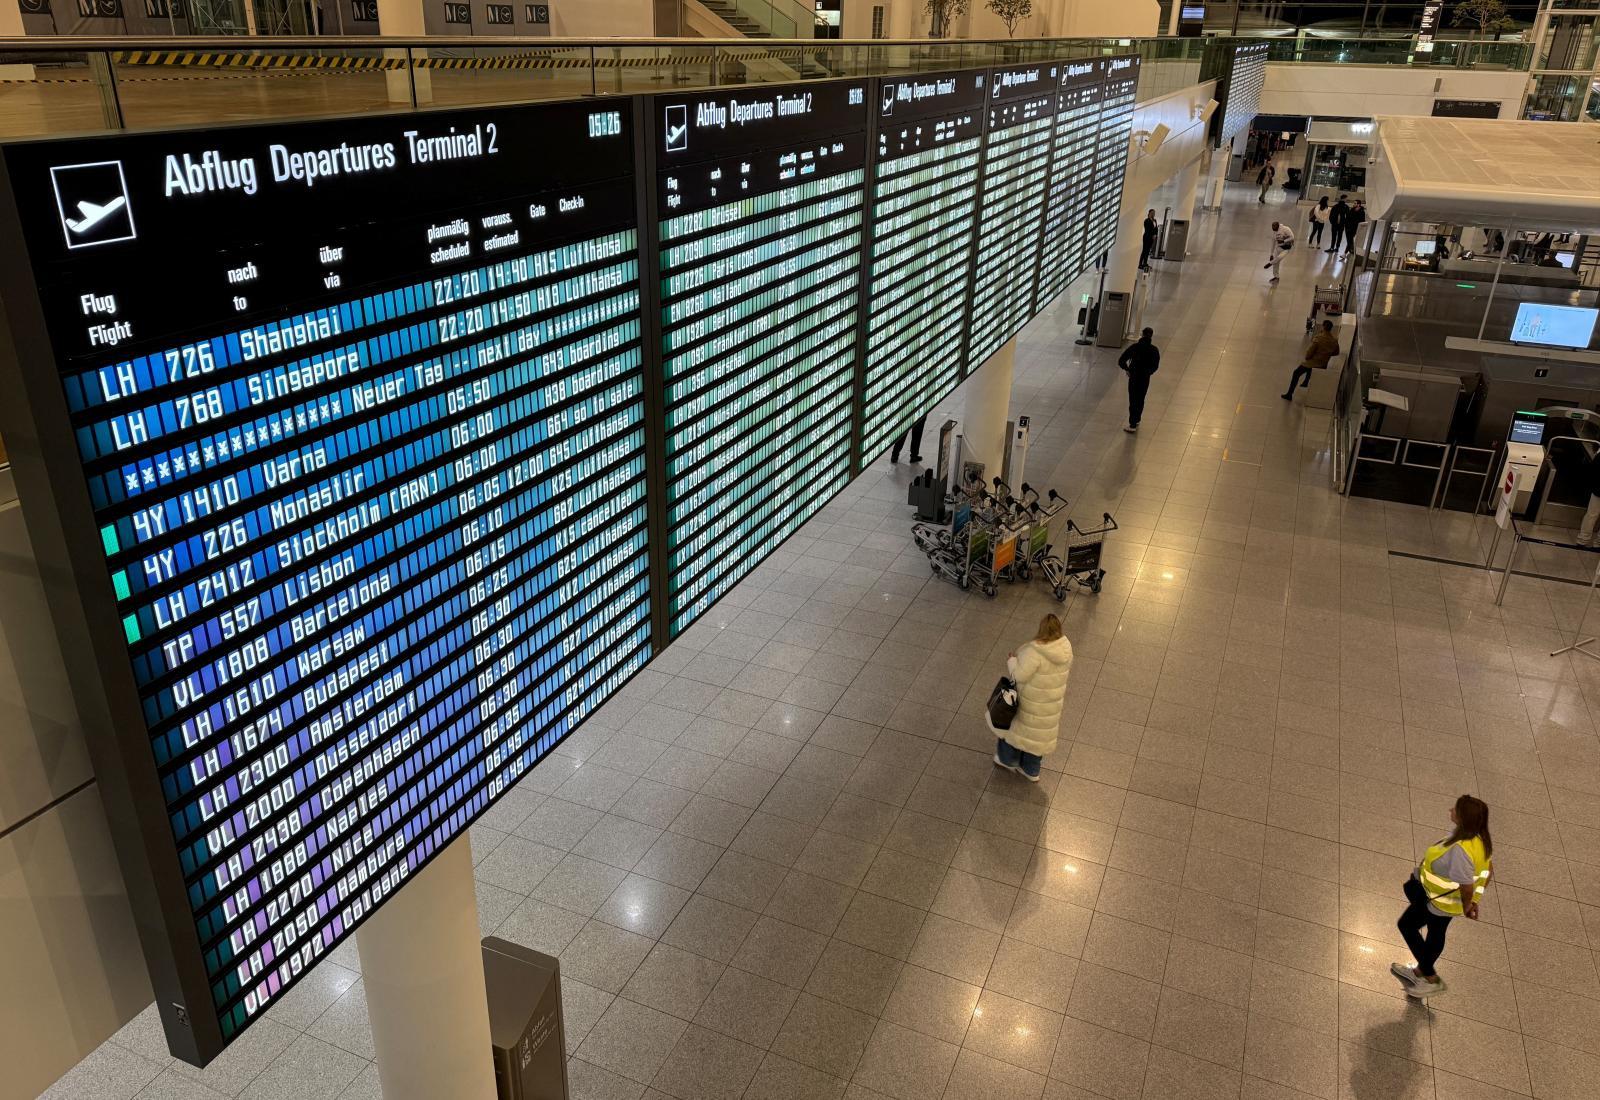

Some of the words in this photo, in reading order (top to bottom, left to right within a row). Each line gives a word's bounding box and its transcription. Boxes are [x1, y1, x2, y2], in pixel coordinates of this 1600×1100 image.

[166, 151, 257, 196] Abflug
[270, 142, 395, 186] Departures
[404, 125, 482, 163] Terminal
[487, 123, 498, 153] 2
[589, 112, 620, 137] 05:26
[668, 177, 677, 190] Flug
[696, 102, 726, 128] Abflug
[731, 100, 773, 126] Departures
[777, 93, 805, 116] Terminal
[807, 93, 812, 112] 2
[228, 262, 257, 283] nach
[320, 246, 343, 263] über
[428, 219, 469, 243] planmäßig
[482, 212, 512, 229] vorauss.
[430, 241, 470, 264] scheduled
[484, 230, 519, 251] estimated
[530, 204, 546, 218] Gate
[559, 195, 584, 212] Check-In
[668, 194, 680, 208] Flight
[712, 257, 733, 280] Paris
[81, 294, 116, 314] Flug
[88, 322, 132, 345] Flight
[99, 363, 137, 402] LH
[165, 343, 214, 382] 726
[240, 309, 341, 361] Shanghai
[434, 272, 479, 305] 22:20
[488, 259, 527, 290] 14:40
[562, 238, 620, 269] Lufthansa
[111, 412, 147, 450] LH
[175, 389, 222, 429] 768
[248, 351, 359, 405] Singapore
[438, 308, 483, 343] 22:20
[492, 293, 530, 326] 14:50
[565, 269, 622, 302] Lufthansa
[233, 296, 247, 310] to
[324, 272, 340, 288] via
[352, 377, 404, 412] Neuer
[414, 363, 443, 389] Tag
[478, 336, 510, 367] next
[518, 330, 539, 352] day
[712, 306, 737, 331] Berlin
[133, 505, 163, 539] 4Y
[183, 477, 239, 522] 1410
[263, 447, 326, 488] Varna
[447, 378, 490, 414] 05:50
[569, 331, 619, 365] boarding
[143, 549, 173, 583] 4Y
[203, 518, 247, 559] 226
[270, 472, 363, 529] Monastir
[451, 412, 493, 448] 06:00
[571, 361, 620, 395] boarding
[153, 592, 186, 629] LH
[198, 559, 254, 607] 2412
[278, 504, 380, 568] Stockholm
[455, 444, 496, 482] 06:00
[574, 406, 586, 424] go
[593, 396, 604, 415] to
[610, 383, 632, 406] gate
[163, 634, 192, 668] TP
[220, 598, 258, 639] 557
[284, 555, 354, 606] Lisbon
[458, 476, 498, 514] 06:05
[508, 454, 542, 489] 12:00
[575, 414, 628, 453] Lufthansa
[172, 677, 203, 708] VL
[218, 636, 268, 684] 1808
[291, 574, 390, 643] Barcelona
[462, 507, 501, 546] 06:10
[577, 440, 629, 481] Lufthansa
[181, 711, 211, 748] LH
[226, 674, 275, 722] 1610
[297, 625, 364, 678] Warsaw
[465, 537, 504, 577] 06:15
[579, 467, 630, 509] Lufthansa
[190, 748, 219, 785] LH
[233, 708, 282, 758] 1674
[303, 642, 387, 712] Budapest
[469, 567, 507, 607] 06:25
[581, 488, 631, 535] cancelled
[199, 785, 227, 821] LH
[238, 744, 288, 794] 2300
[310, 671, 403, 746] Amsterdam
[472, 595, 509, 636] 06:30
[582, 517, 632, 562] Lufthansa
[207, 825, 235, 854] VL
[245, 778, 294, 829] 2000
[315, 692, 414, 779] Dusseldorf
[475, 624, 512, 665] 06:30
[584, 542, 633, 588] Lufthansa
[215, 854, 242, 890] LH
[252, 811, 300, 862] 2438
[321, 726, 419, 810] Copenhagen
[477, 651, 514, 693] 06:30
[585, 566, 634, 612] Lufthansa
[222, 887, 249, 923] LH
[262, 842, 306, 892] 1888
[326, 783, 387, 842] Naples
[480, 678, 516, 720] 06:30
[586, 590, 635, 638] Lufthansa
[230, 919, 256, 955] LH
[266, 873, 312, 926] 2270
[332, 824, 373, 871] Nice
[483, 705, 519, 747] 06:35
[588, 613, 636, 662] Lufthansa
[237, 950, 263, 986] LH
[272, 904, 318, 956] 2050
[337, 834, 404, 901] Hamburg
[486, 731, 521, 774] 06:45
[589, 636, 637, 686] Lufthansa
[244, 982, 269, 1014] VL
[279, 933, 324, 985] 1972
[342, 859, 408, 929] Cologne
[488, 756, 523, 800] 06:45
[590, 658, 638, 709] Lufthansa
